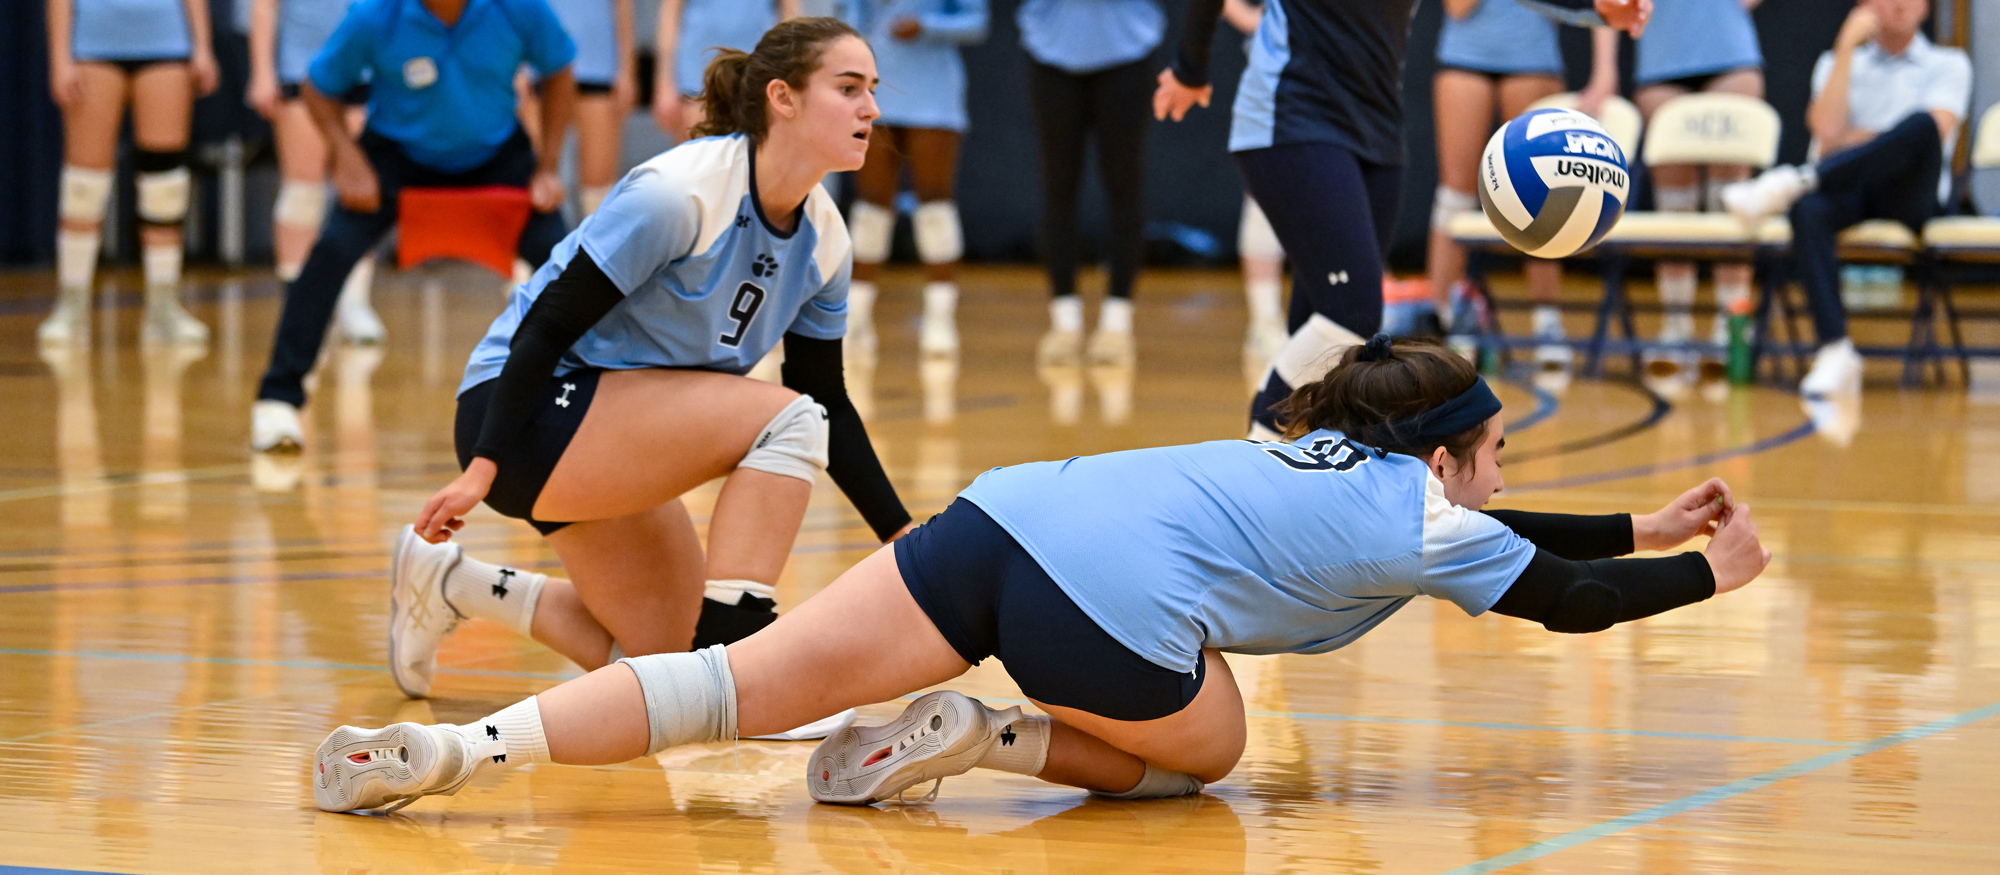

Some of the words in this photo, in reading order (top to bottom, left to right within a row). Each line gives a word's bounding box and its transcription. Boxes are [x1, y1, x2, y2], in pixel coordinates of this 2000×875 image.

[1565, 131, 1621, 164] NCAA
[1557, 159, 1625, 189] molten
[717, 280, 766, 349] 9
